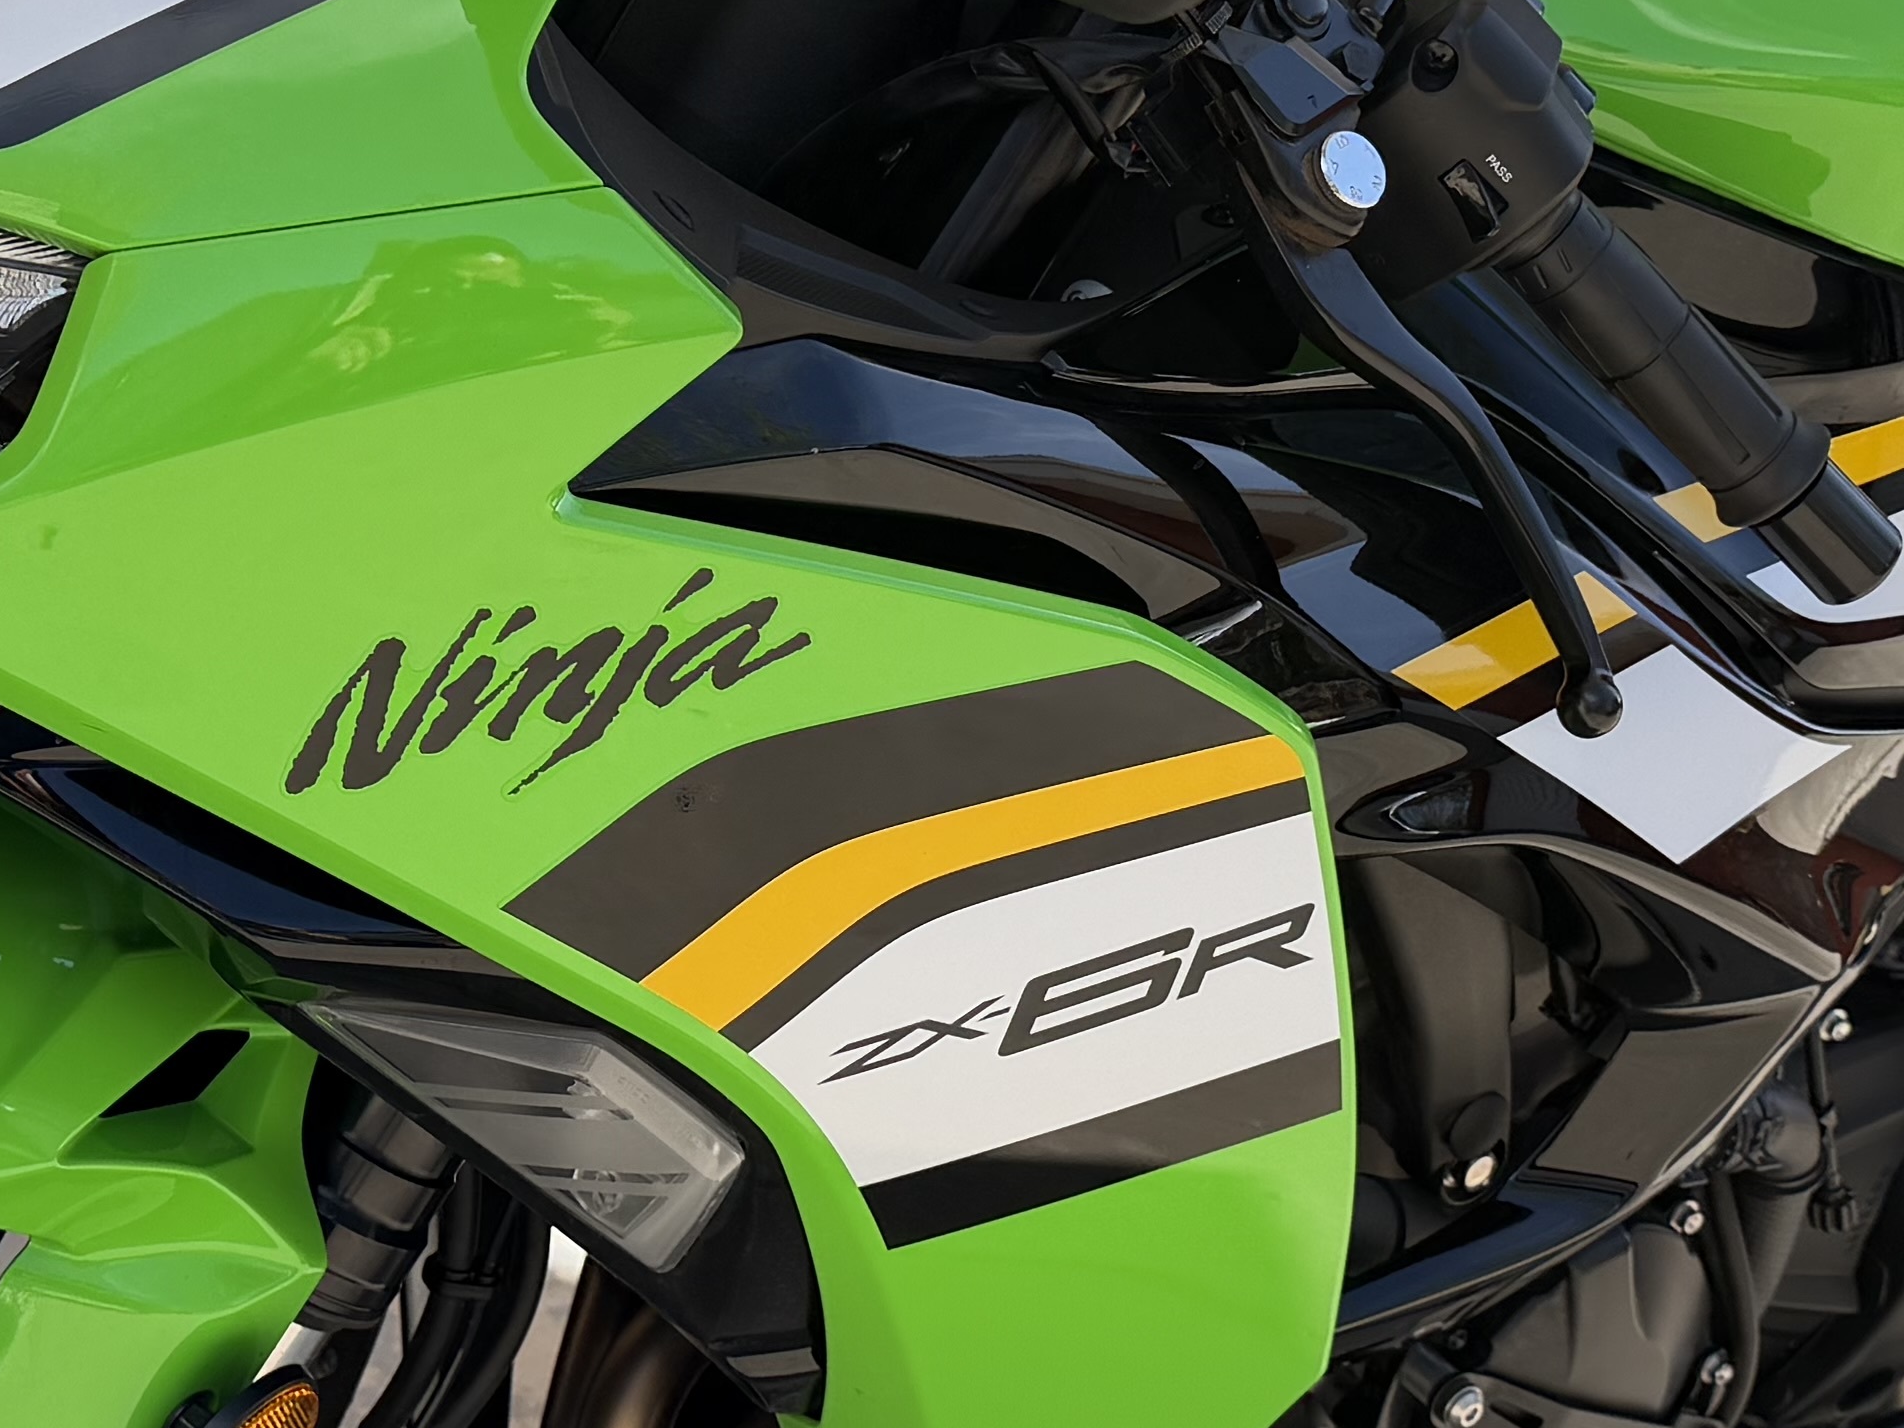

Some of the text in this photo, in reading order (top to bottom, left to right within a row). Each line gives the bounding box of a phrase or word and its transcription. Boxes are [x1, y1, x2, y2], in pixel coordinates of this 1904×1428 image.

[1485, 154, 1513, 182] PASS
[284, 567, 812, 795] Ninja
[817, 902, 1316, 1085] ZX-6R
